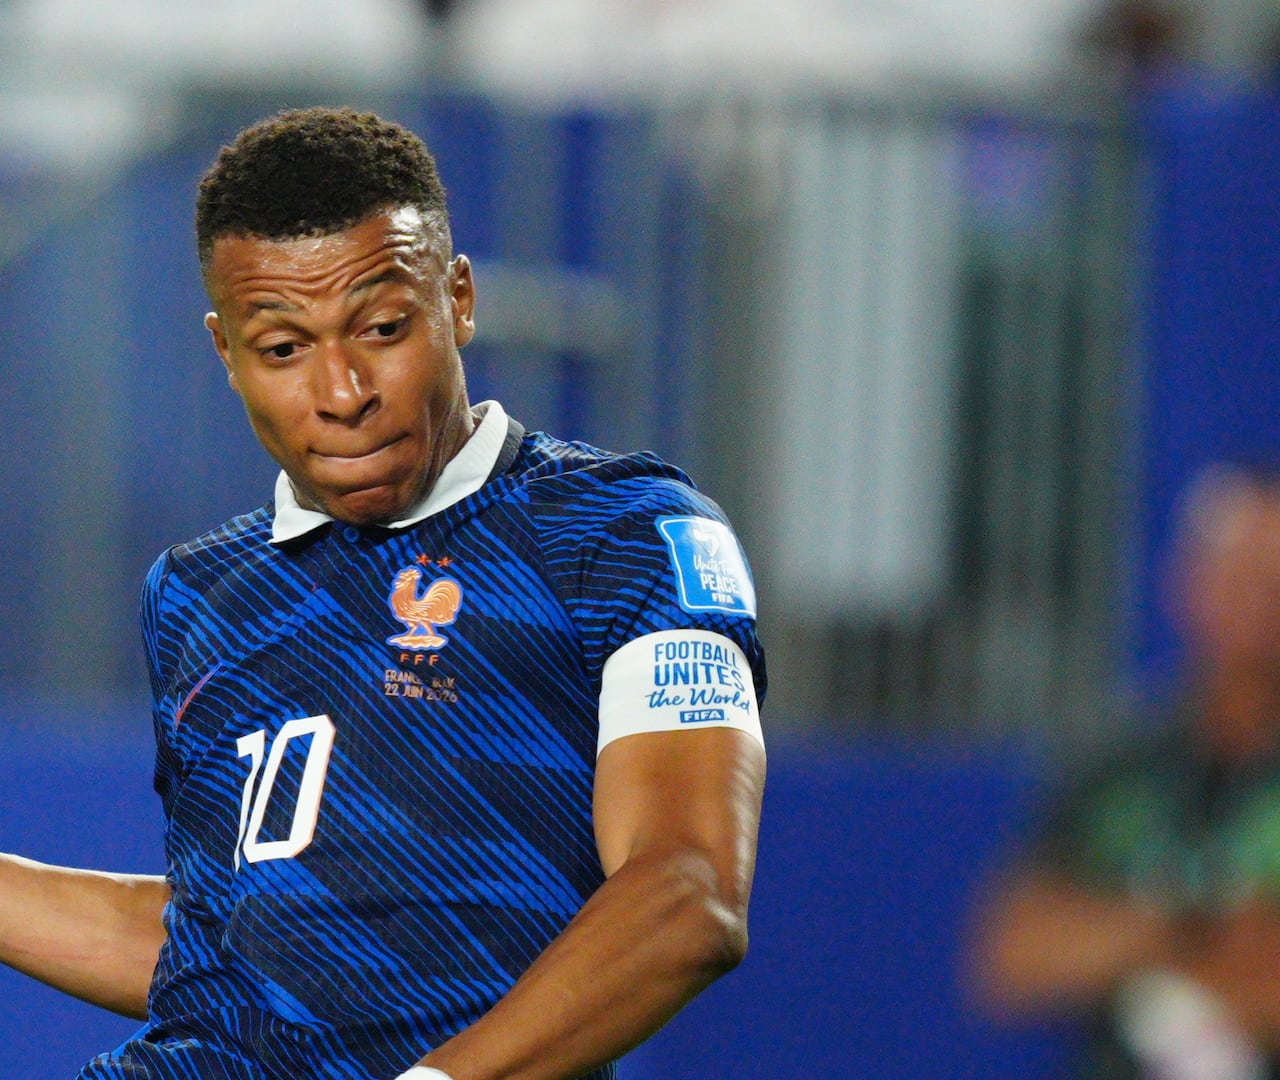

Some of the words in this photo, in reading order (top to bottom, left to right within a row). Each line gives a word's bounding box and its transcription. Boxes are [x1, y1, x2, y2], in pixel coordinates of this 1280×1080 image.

[700, 573, 739, 593] PEACE
[712, 593, 735, 604] FIFA
[654, 641, 740, 670] FOOTBALL
[654, 662, 745, 692] UNITES
[384, 683, 399, 696] 22
[645, 688, 685, 708] the
[689, 688, 750, 713] World
[683, 710, 722, 721] FIFA
[233, 714, 336, 873] 10
